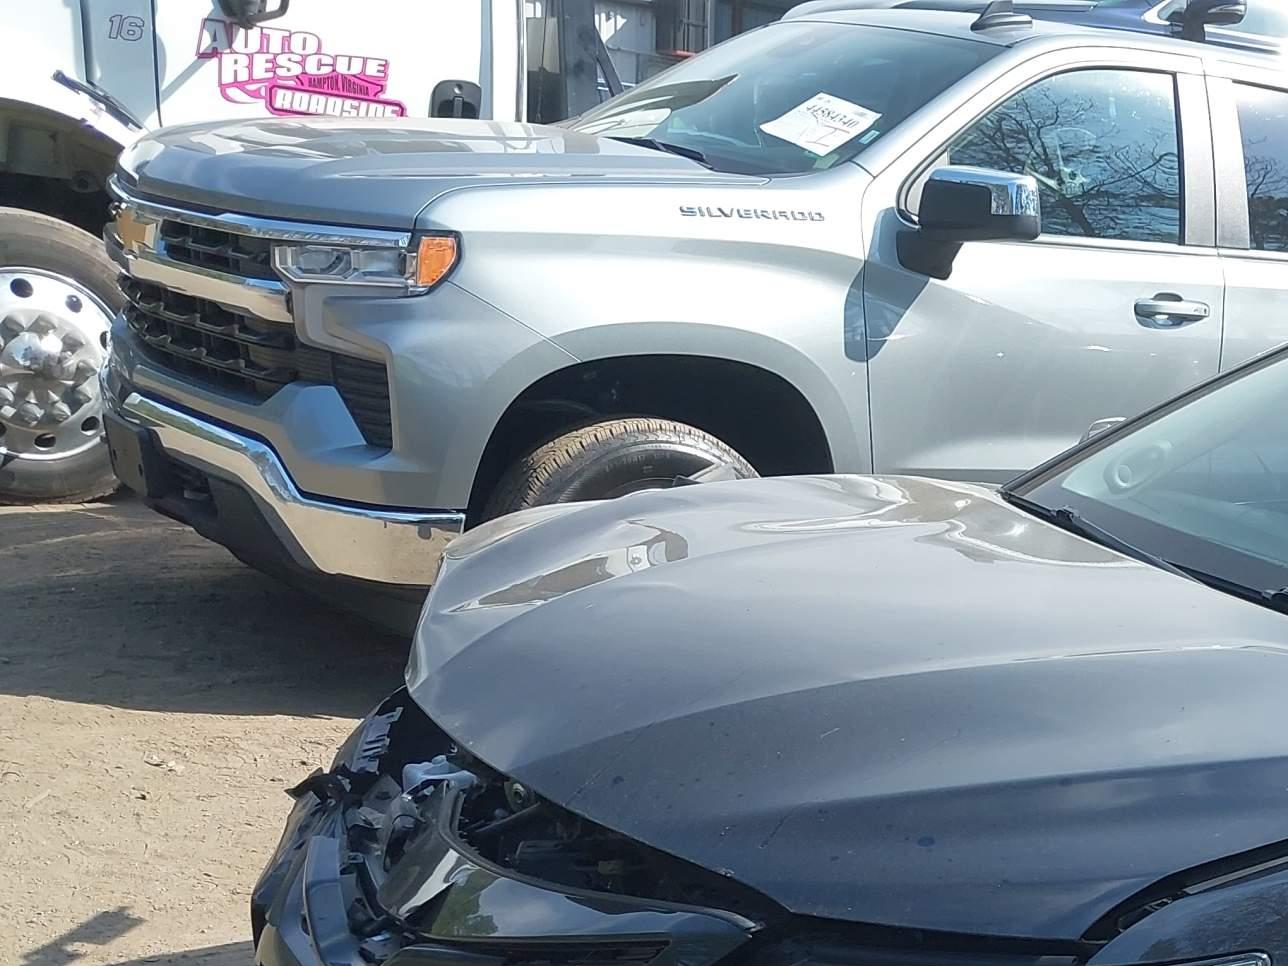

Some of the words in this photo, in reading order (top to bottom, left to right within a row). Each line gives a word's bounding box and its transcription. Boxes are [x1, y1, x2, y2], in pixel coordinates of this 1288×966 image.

[109, 14, 145, 41] 16
[197, 18, 320, 58] AUTO
[220, 52, 388, 85] RESCUE
[341, 74, 369, 97] VIRGINIA
[273, 90, 402, 118] ROADSIDE
[679, 205, 825, 222] SILVERADO
